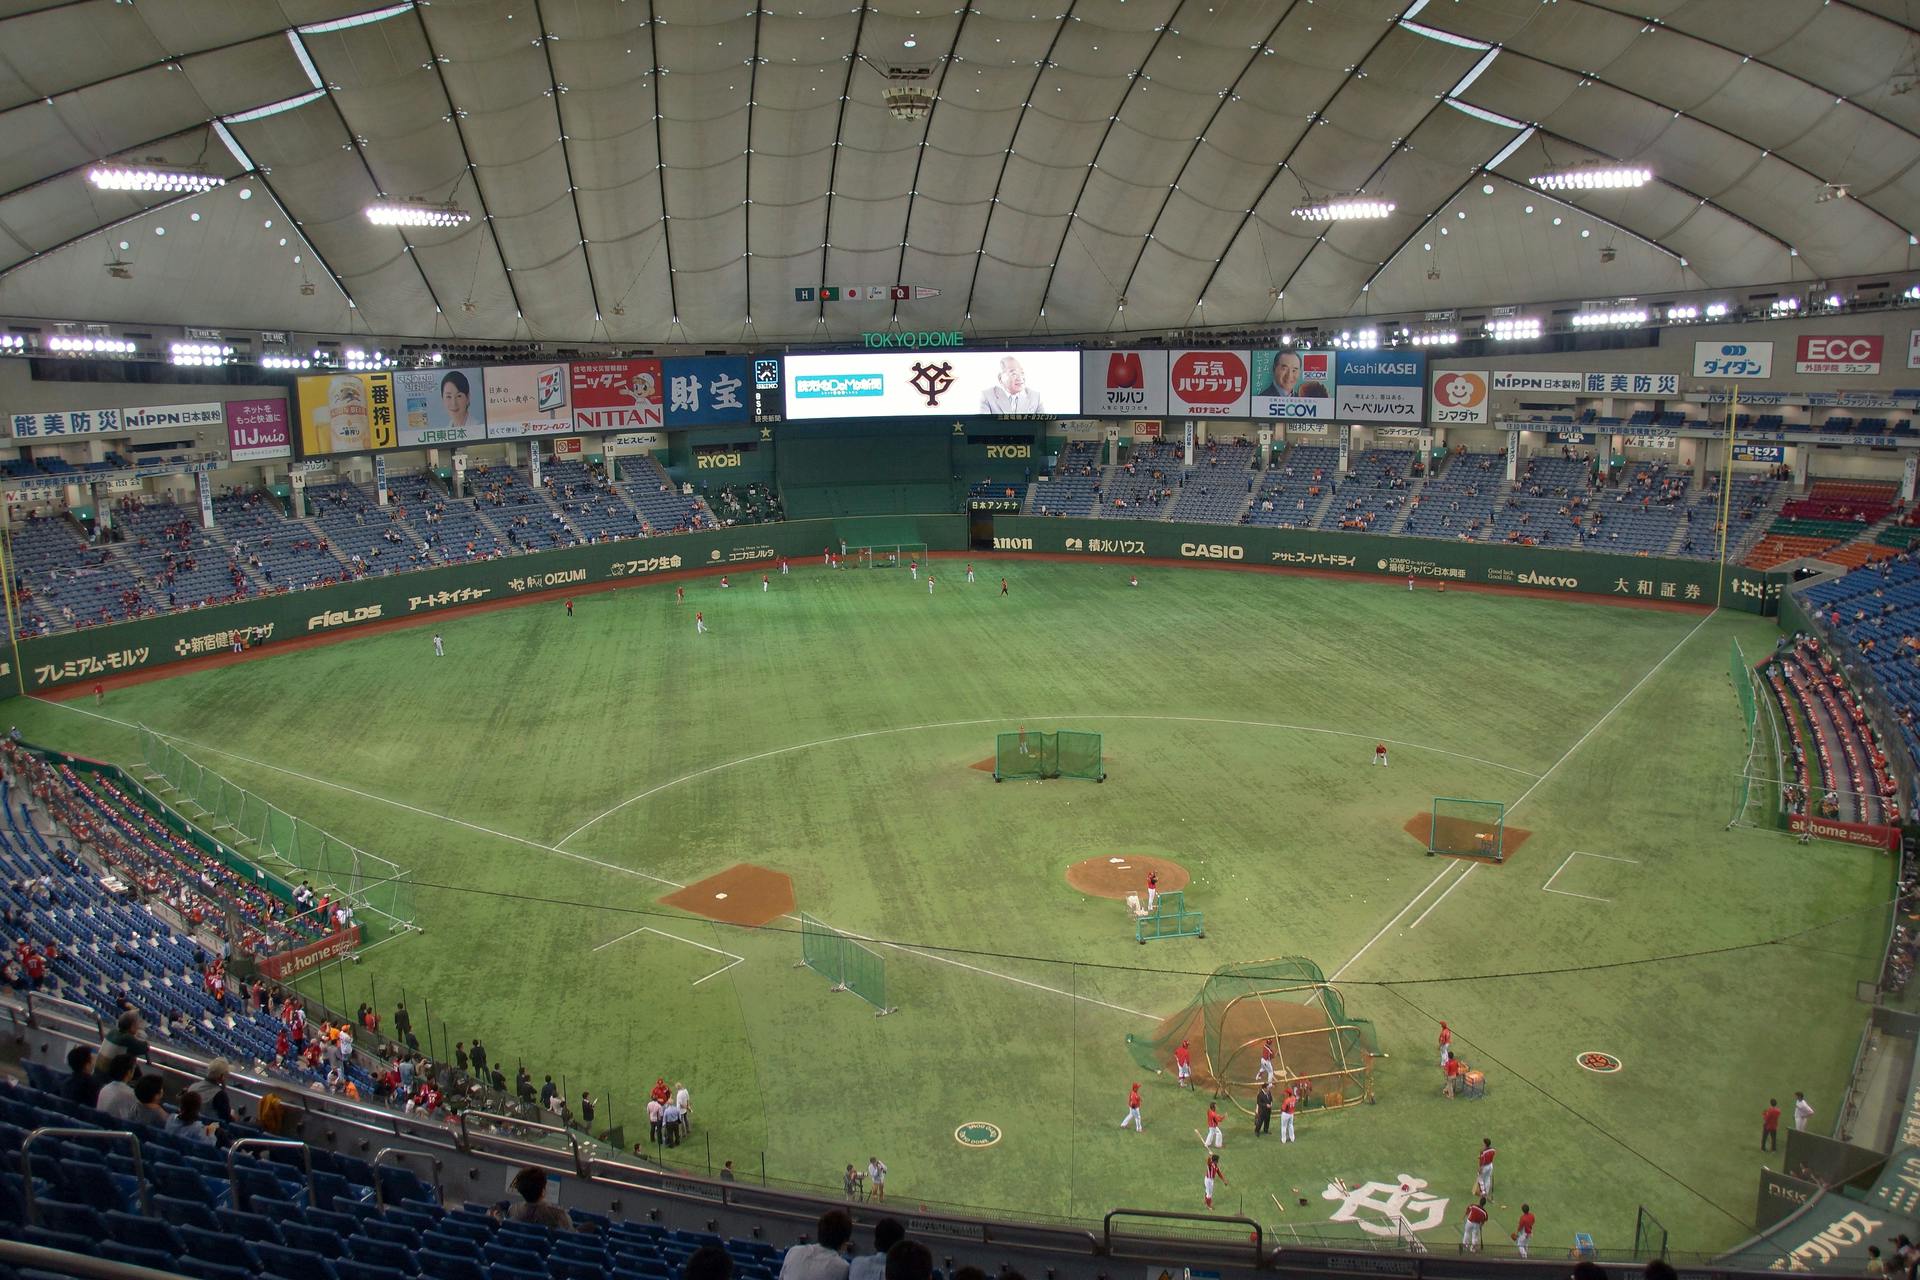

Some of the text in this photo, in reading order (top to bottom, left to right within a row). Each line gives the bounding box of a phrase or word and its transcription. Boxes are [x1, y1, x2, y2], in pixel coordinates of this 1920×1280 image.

[862, 331, 964, 347] TOKYO DOME
[1807, 339, 1871, 361] ECC
[1193, 361, 1224, 376] 元気
[1703, 360, 1762, 375] ダイダン
[1805, 364, 1871, 372] 外語学院 ジュニア
[573, 373, 627, 389] ニッタン
[1178, 377, 1242, 392] ハツラツ!
[1544, 379, 1580, 390] 日本製粉
[1587, 374, 1676, 393] 能美防災
[671, 374, 743, 412] 財宝
[1107, 392, 1144, 404] マルハン
[243, 404, 272, 414] ネットを
[370, 375, 391, 446] 一番搾り
[1269, 404, 1316, 417] SECOM
[1343, 403, 1414, 414] ヘーベルハウス
[1438, 409, 1479, 421] シマダヤ
[14, 411, 119, 437] 能美防災
[182, 410, 221, 423] 日本製粉
[236, 413, 282, 424] もっと快適に
[577, 408, 661, 428] NITTAN
[234, 428, 285, 446] IIJmio
[418, 428, 467, 443] JR東日本
[987, 445, 1031, 458] RYOBI
[698, 453, 741, 469] RYOBI
[972, 502, 1018, 510] 日本アンテナ
[993, 537, 1032, 550] anon
[1088, 538, 1146, 555] 積水ハウス
[1181, 543, 1244, 559] CASIO
[729, 549, 774, 561] コニカミノルタ
[1272, 552, 1357, 567] アサヒ スーパードライ
[626, 554, 682, 574] フコク生命
[1389, 564, 1467, 578] 損保ジャパン日本興亜
[545, 568, 586, 585] OIZUMI
[1518, 569, 1577, 588] SANKYO
[1613, 577, 1701, 600] 大和証券
[408, 588, 491, 610] アートネイチャー
[1791, 820, 1805, 831] at
[1810, 820, 1847, 838] home
[281, 964, 292, 976] at
[294, 946, 331, 971] home
